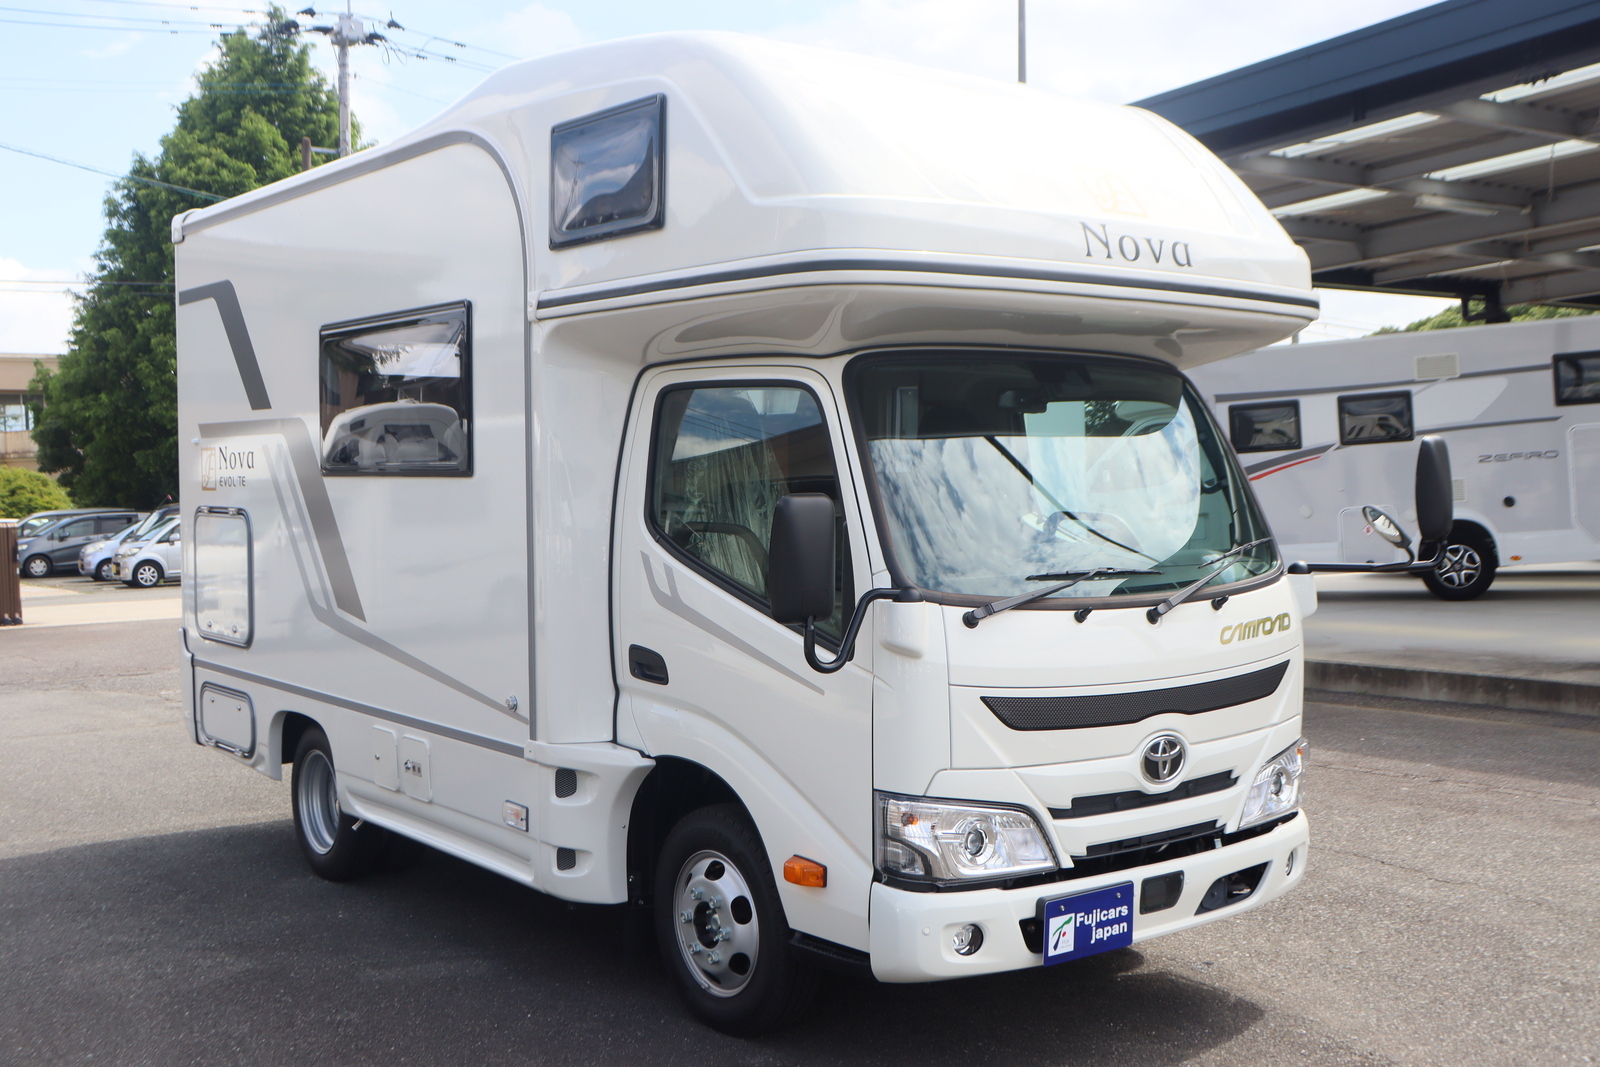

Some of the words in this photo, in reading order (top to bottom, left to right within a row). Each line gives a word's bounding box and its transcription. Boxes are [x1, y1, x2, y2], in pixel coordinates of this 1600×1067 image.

[1079, 221, 1193, 267] Nova
[219, 446, 254, 469] Nova
[1478, 450, 1559, 463] ZEFIRO
[1076, 905, 1129, 927] Fujicars
[1090, 922, 1128, 944] japan
